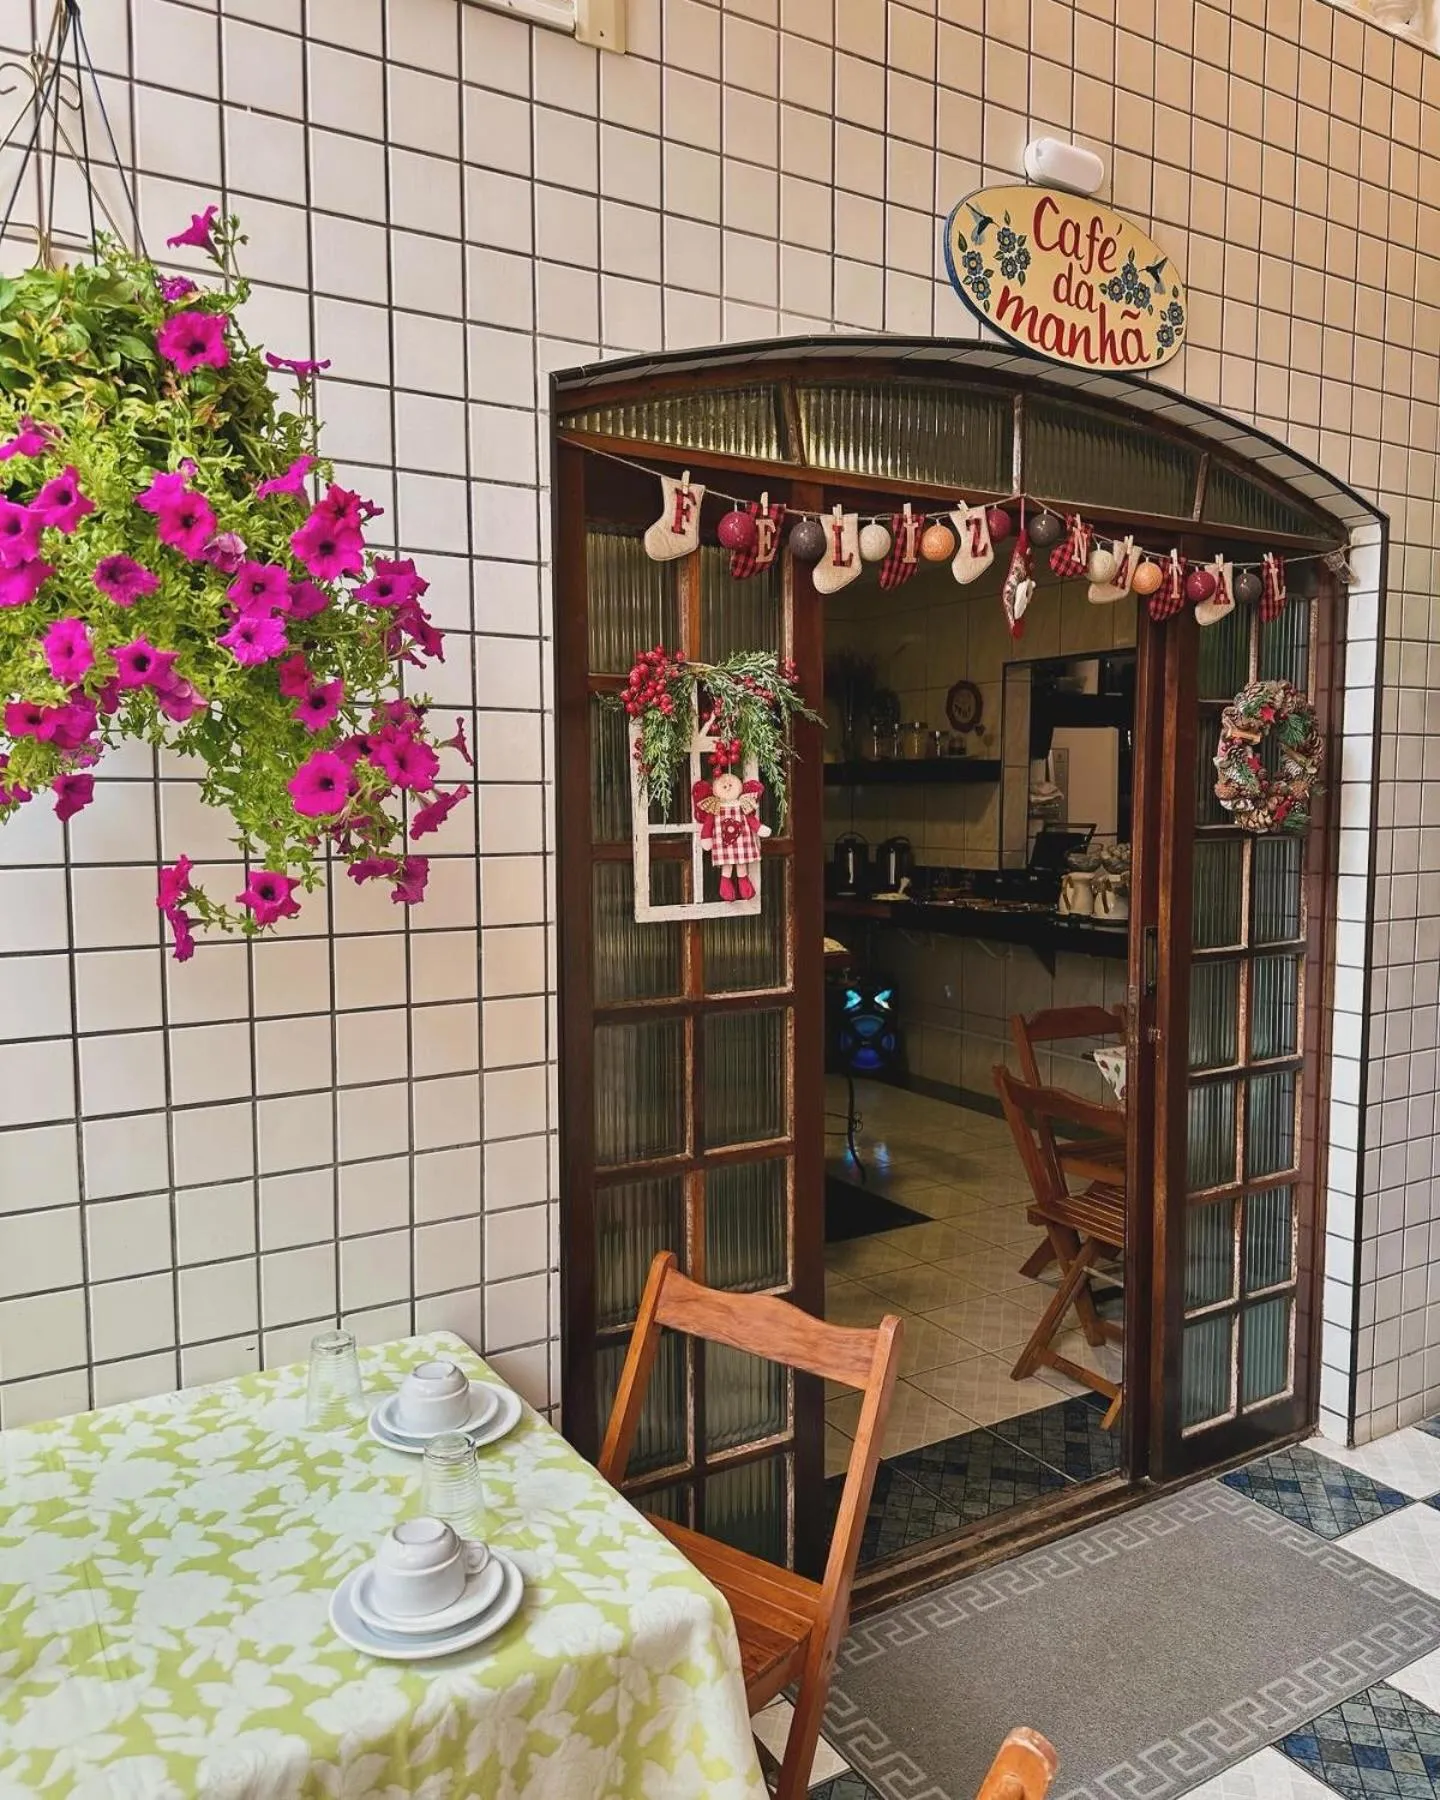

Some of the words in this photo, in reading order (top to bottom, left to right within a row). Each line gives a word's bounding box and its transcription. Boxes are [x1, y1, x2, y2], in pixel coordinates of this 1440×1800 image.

[1033, 196, 1122, 275] Café
[996, 285, 1150, 366] manhã
[1053, 262, 1098, 313] da
[671, 487, 989, 567] FELIZ
